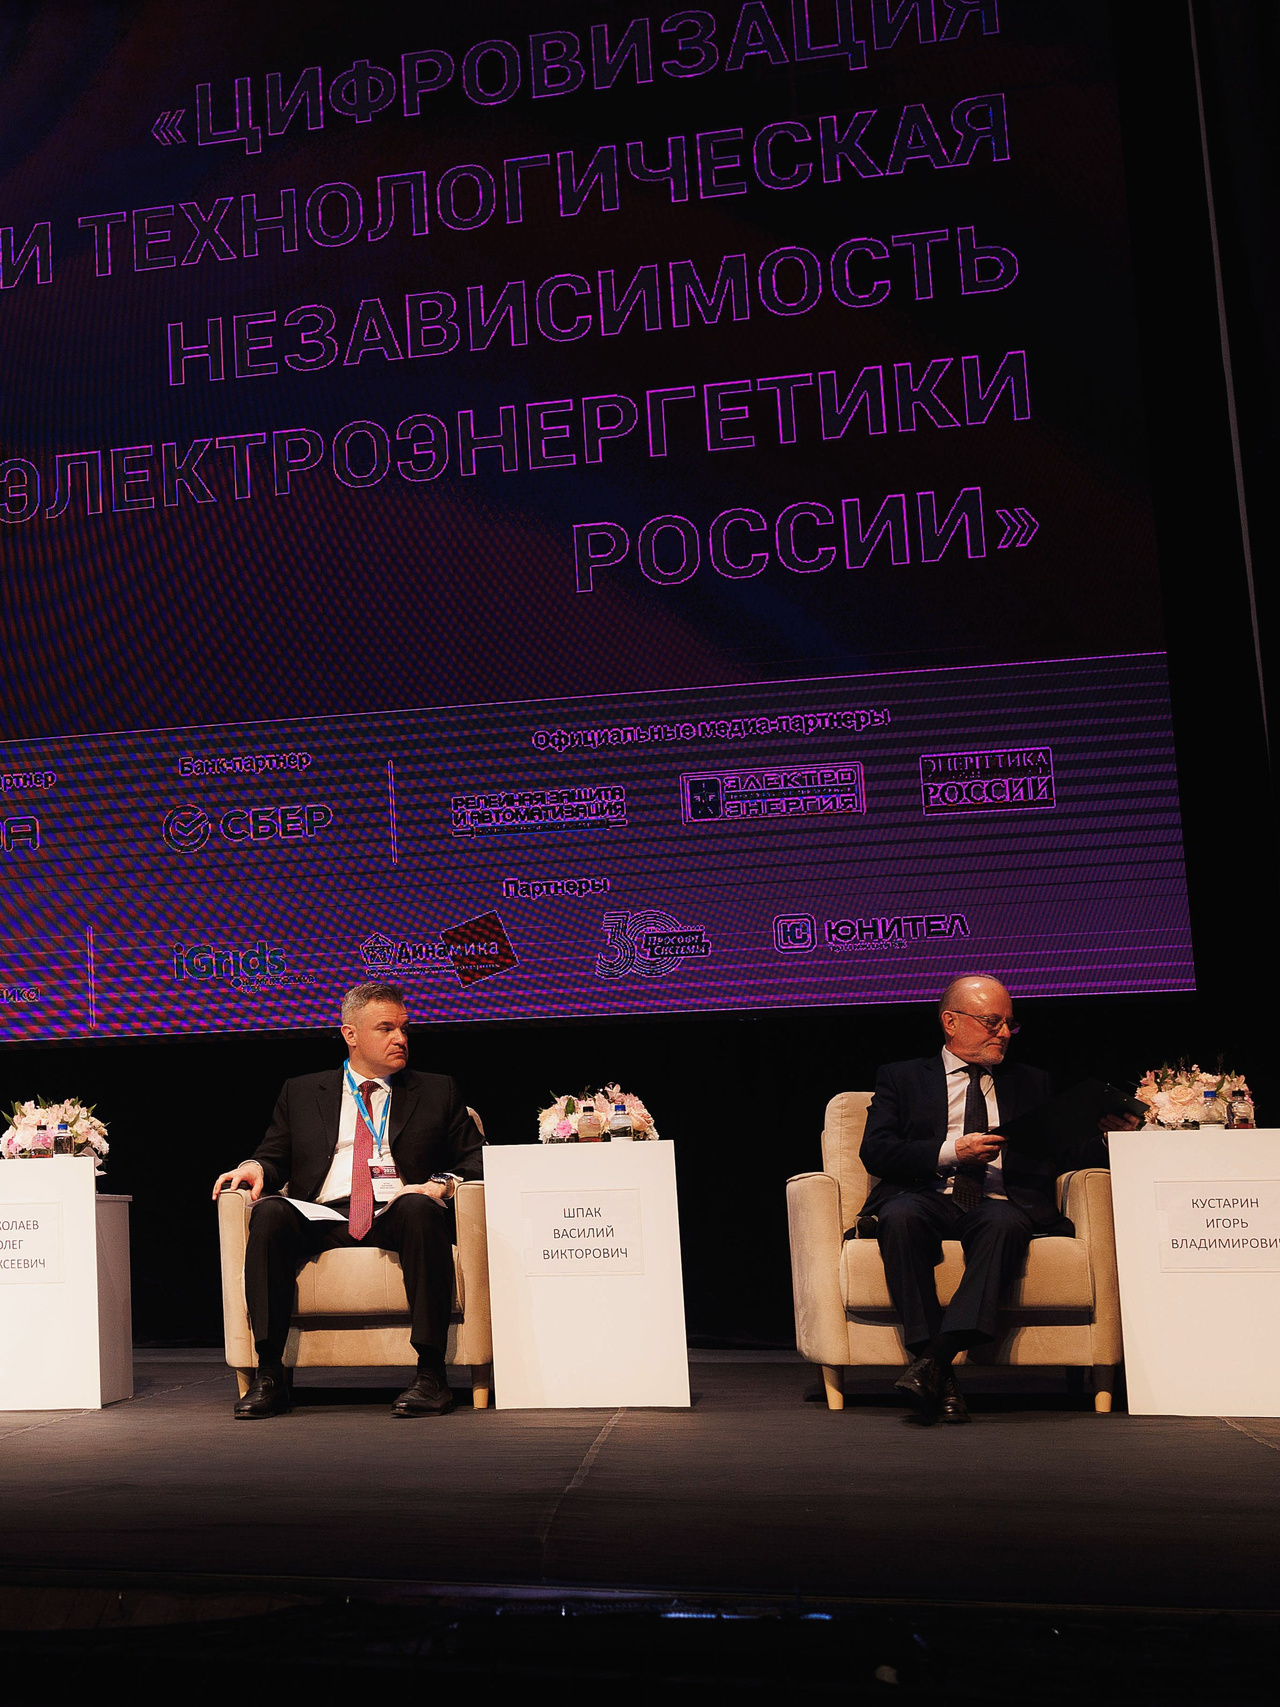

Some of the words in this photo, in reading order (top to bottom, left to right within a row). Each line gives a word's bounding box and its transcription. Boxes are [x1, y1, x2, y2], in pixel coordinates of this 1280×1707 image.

[78, 93, 1010, 276] ТЕХНОЛОГИЧЕСКАЯ
[168, 226, 1018, 386] НЕЗАВИСИМОСТЬ
[573, 487, 1039, 593] РОССИИ»
[532, 721, 696, 752] Официальные
[698, 708, 891, 739] медиа-партнеры
[178, 752, 312, 777] Банк-партнер
[923, 776, 1054, 807] РОССИИ
[220, 804, 333, 841] СБЕР
[469, 801, 626, 827] АВТОМАТИЗАЦИЯ
[503, 878, 610, 900] Партнеры
[825, 914, 970, 943] ЮНИТЕЛ
[397, 941, 498, 964] Динамика
[563, 1207, 602, 1218] ШПАК
[1191, 1198, 1259, 1209] КУСТАРИН
[553, 1225, 614, 1239] ВАСИЛИЙ
[1206, 1218, 1249, 1229] ИГОРЬ
[542, 1248, 628, 1260] ВИКТОРОВИЧ
